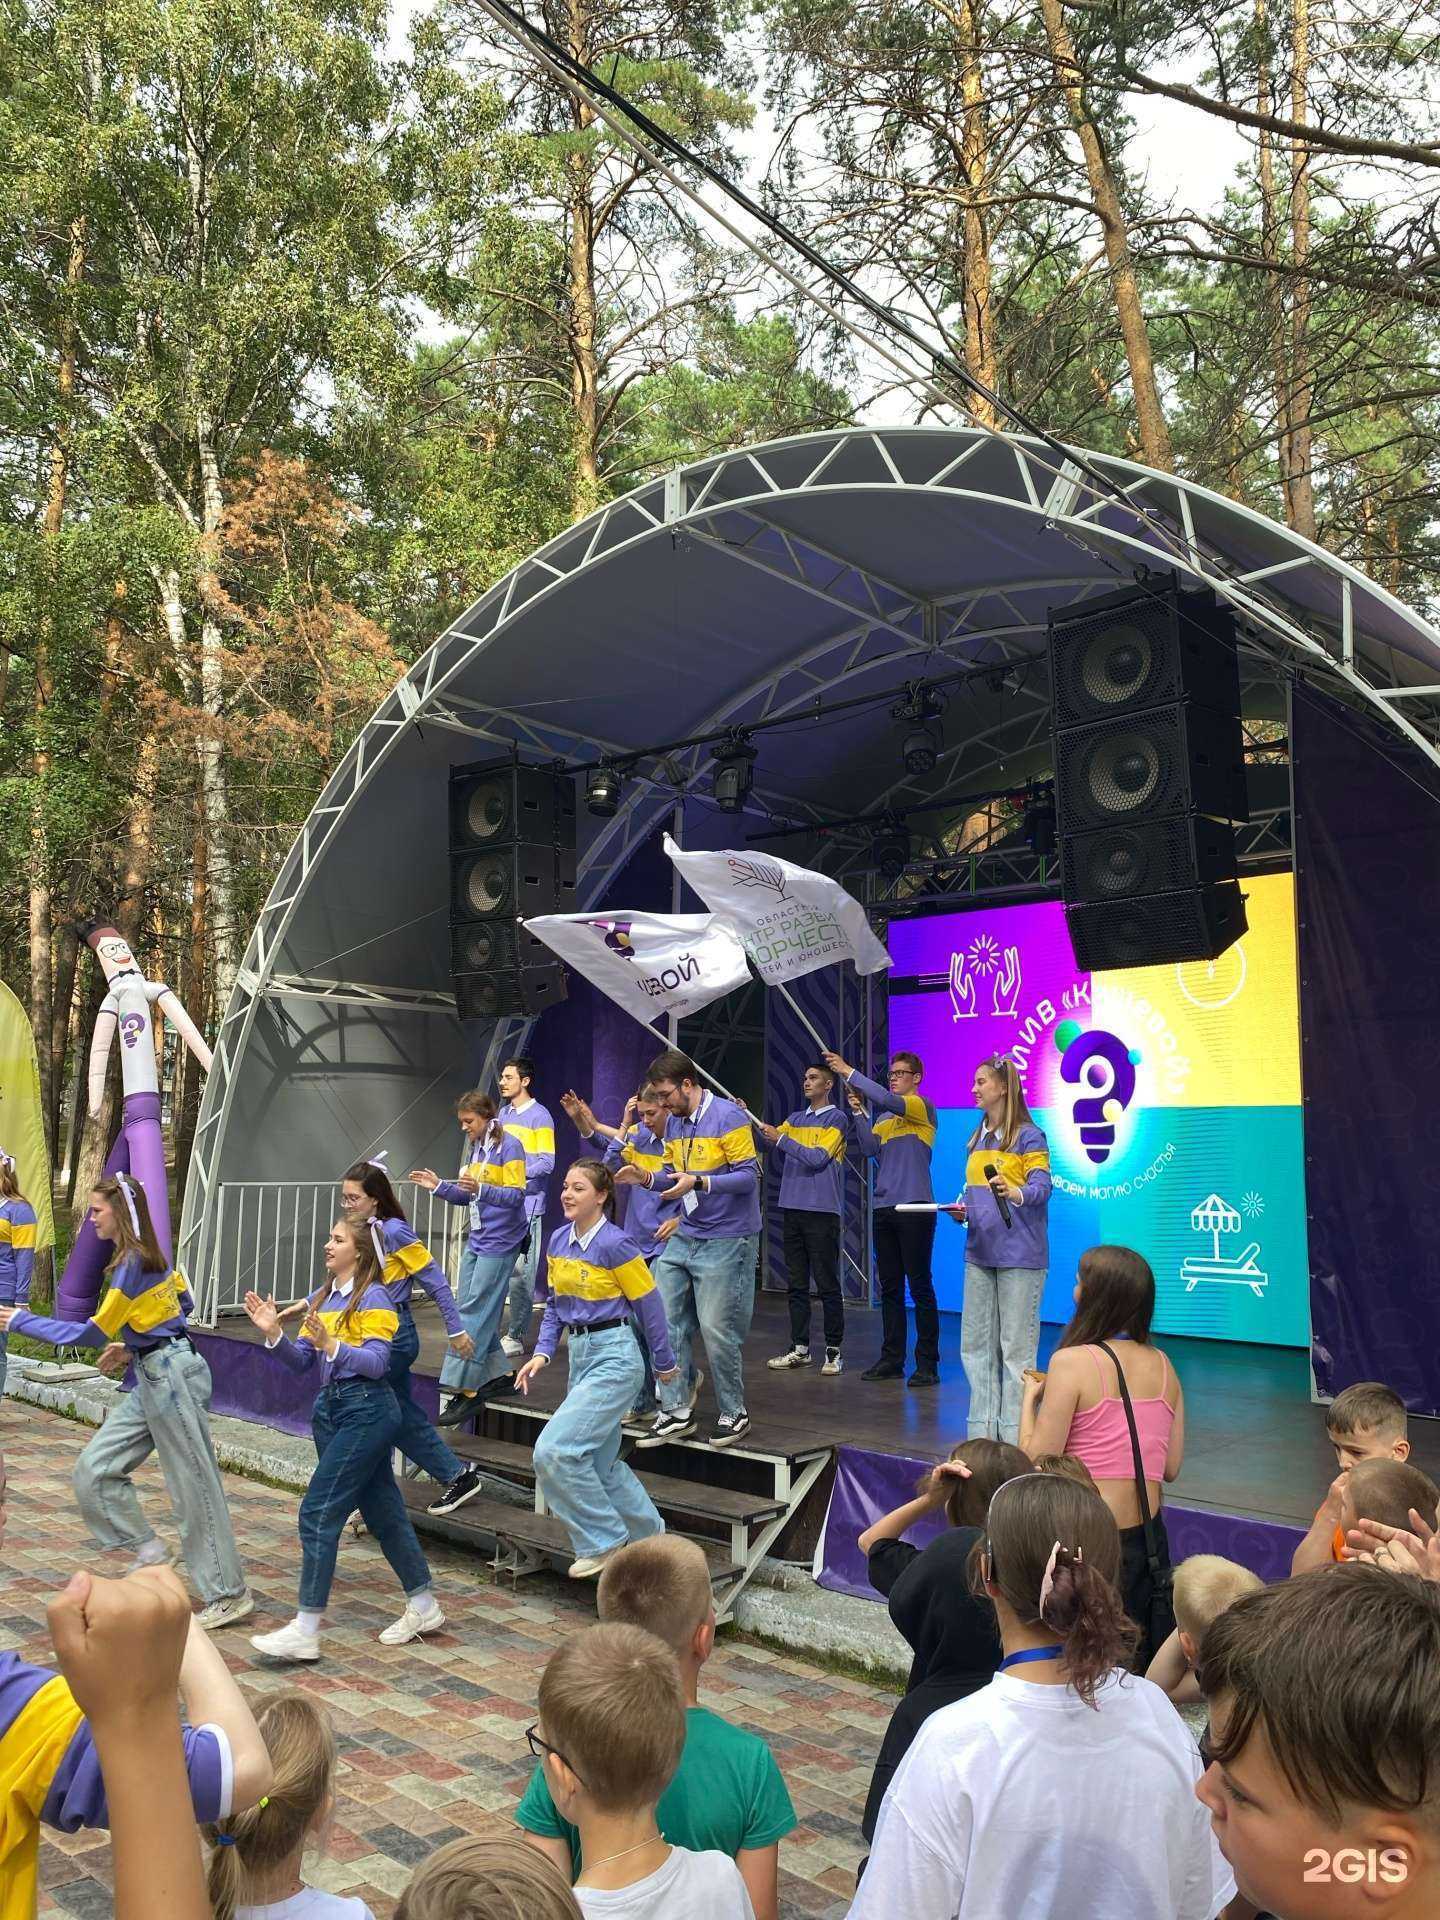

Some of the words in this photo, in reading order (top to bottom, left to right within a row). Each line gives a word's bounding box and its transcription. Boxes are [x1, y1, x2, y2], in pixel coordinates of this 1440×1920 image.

[756, 903, 819, 926] ОБЛАСТН
[798, 941, 849, 962] ЮНОШЕС
[1089, 1181, 1132, 1200] магию
[1133, 1142, 1177, 1190] счастья
